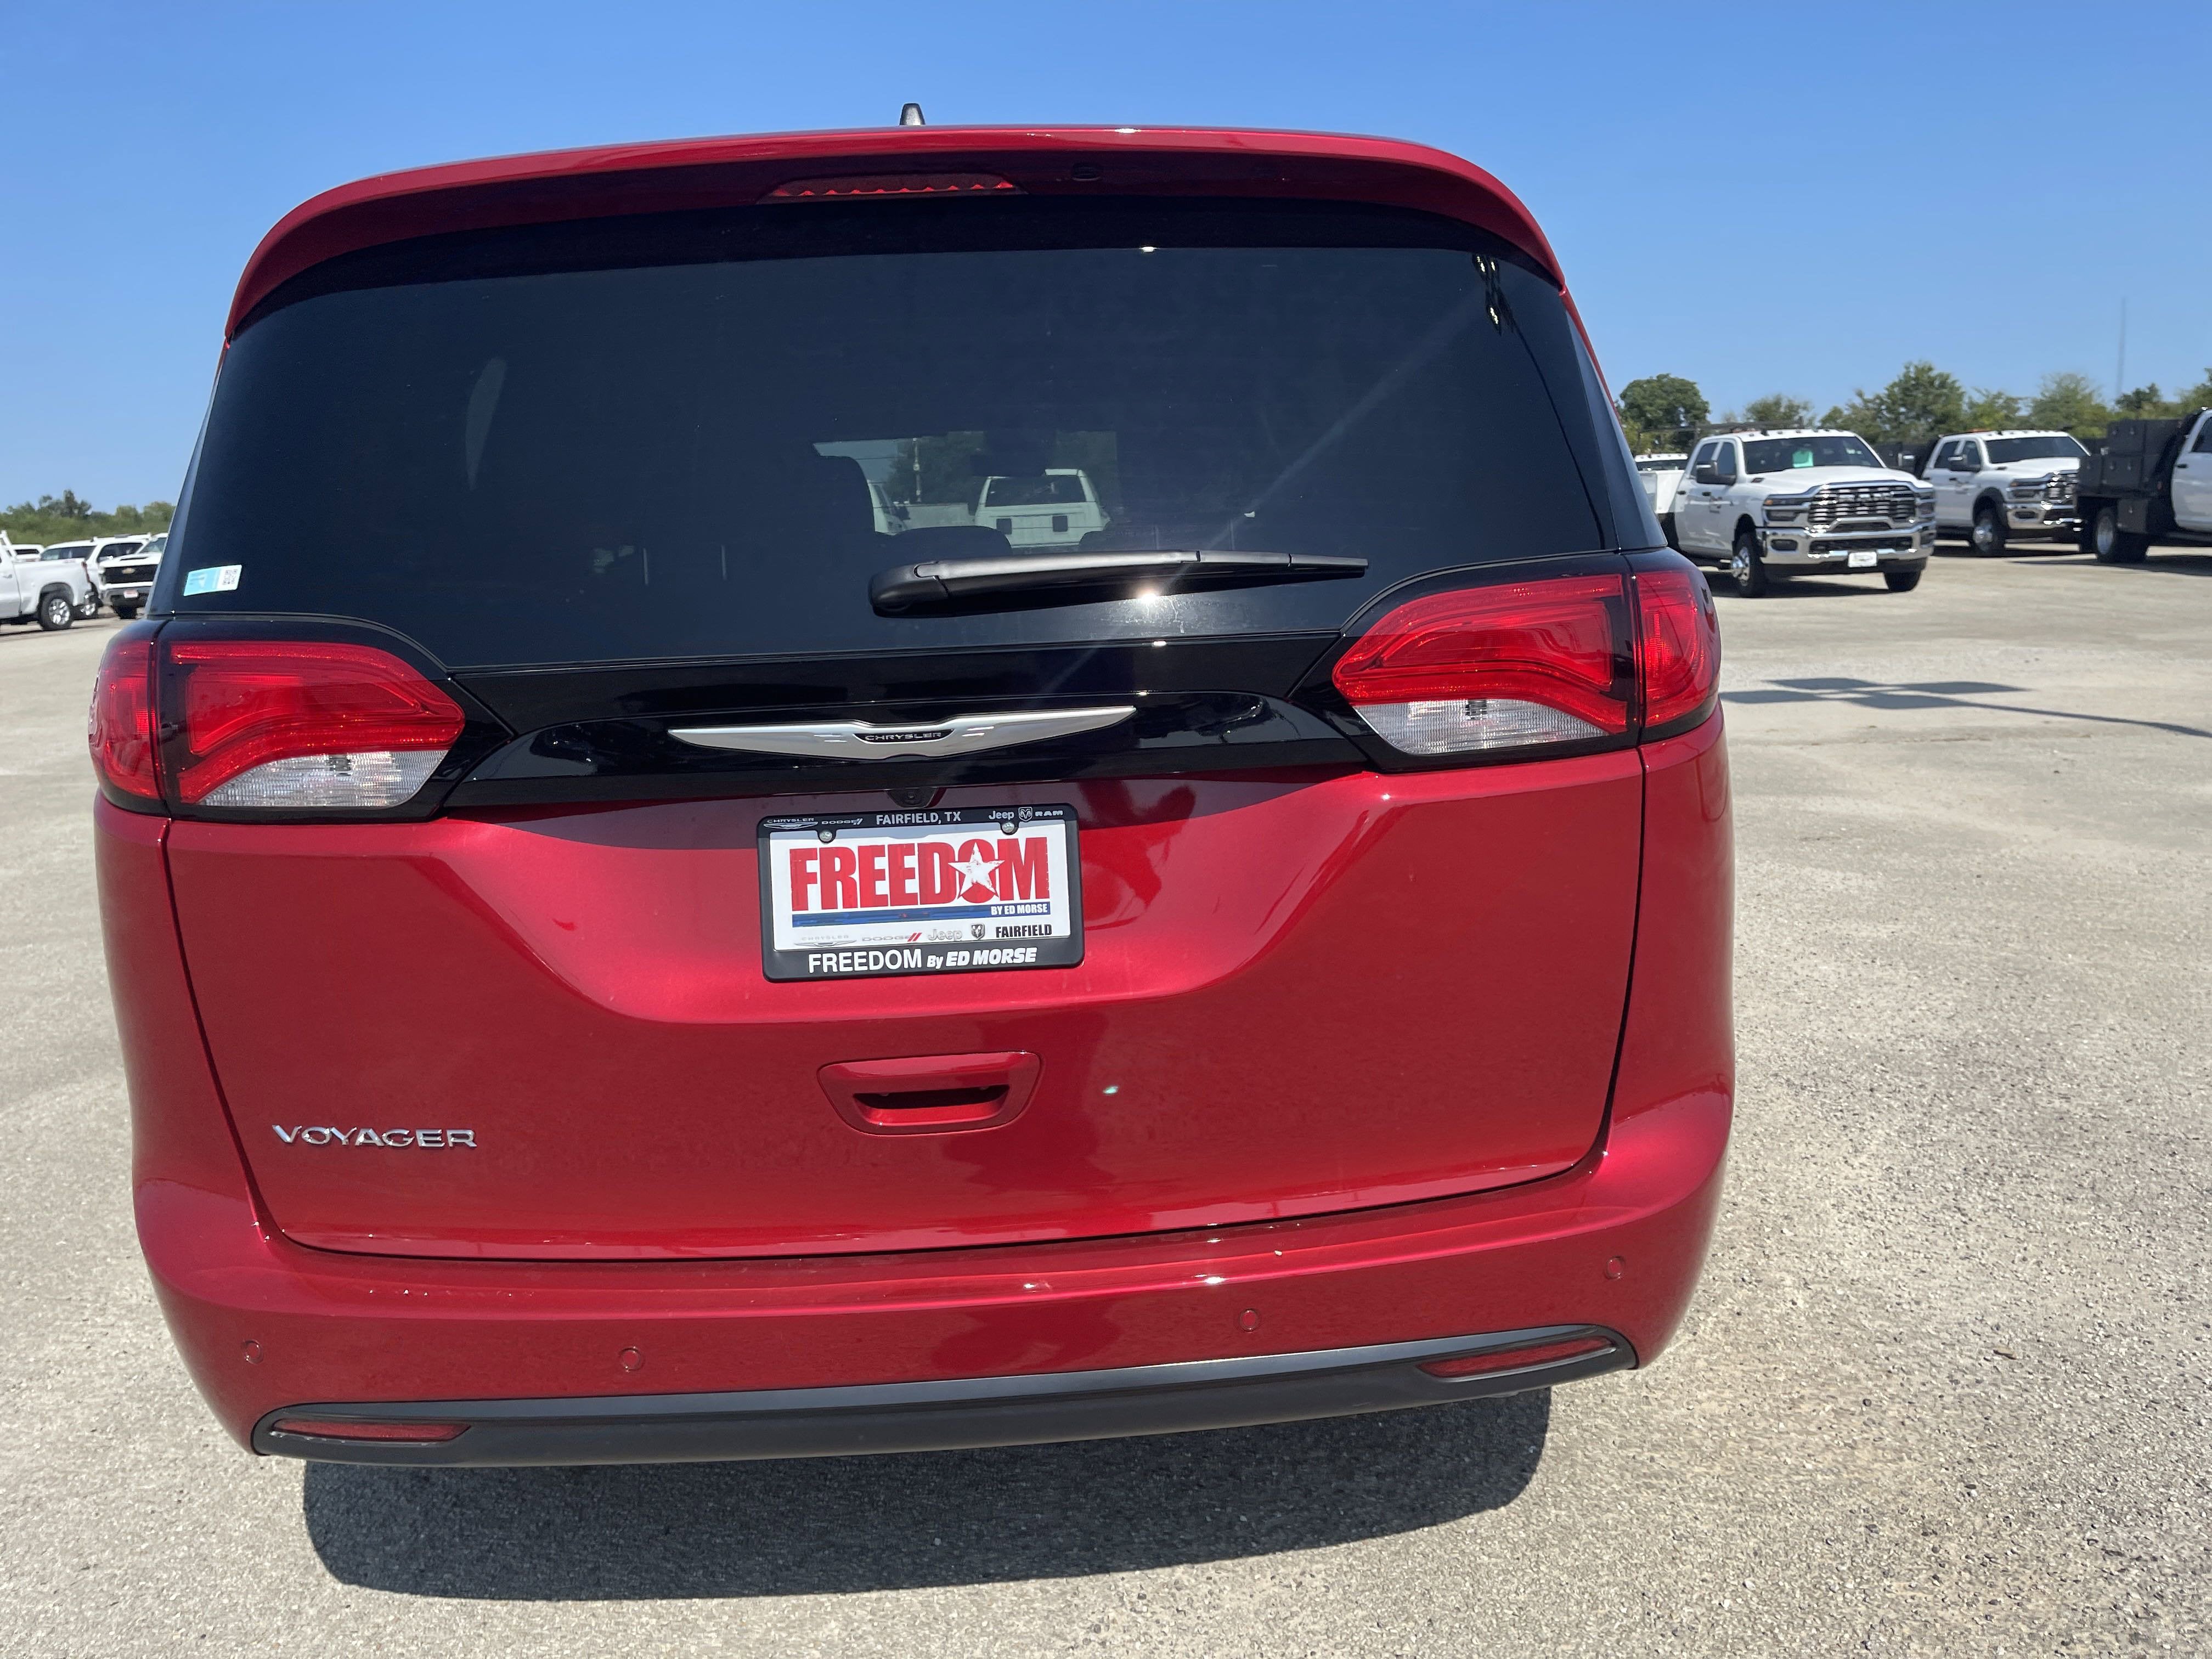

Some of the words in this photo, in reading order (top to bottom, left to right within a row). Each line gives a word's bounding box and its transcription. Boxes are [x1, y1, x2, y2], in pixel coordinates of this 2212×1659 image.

[865, 732, 941, 741] CHRYSLER
[876, 812, 941, 825] FAIRFIELD,
[945, 811, 961, 822] TX
[989, 810, 1014, 820] Jeep
[789, 837, 1050, 911] FREEDOM
[991, 906, 1003, 916] BY
[1005, 905, 1015, 915] ED
[1017, 904, 1048, 913] MORSE
[928, 929, 962, 941] Jeep
[996, 924, 1052, 938] FAIRFIELD
[808, 949, 922, 973] FREEDOM
[927, 954, 943, 969] By
[946, 951, 970, 967] ED
[972, 947, 1037, 965] MORSE
[272, 1124, 477, 1148] VOYAGER
